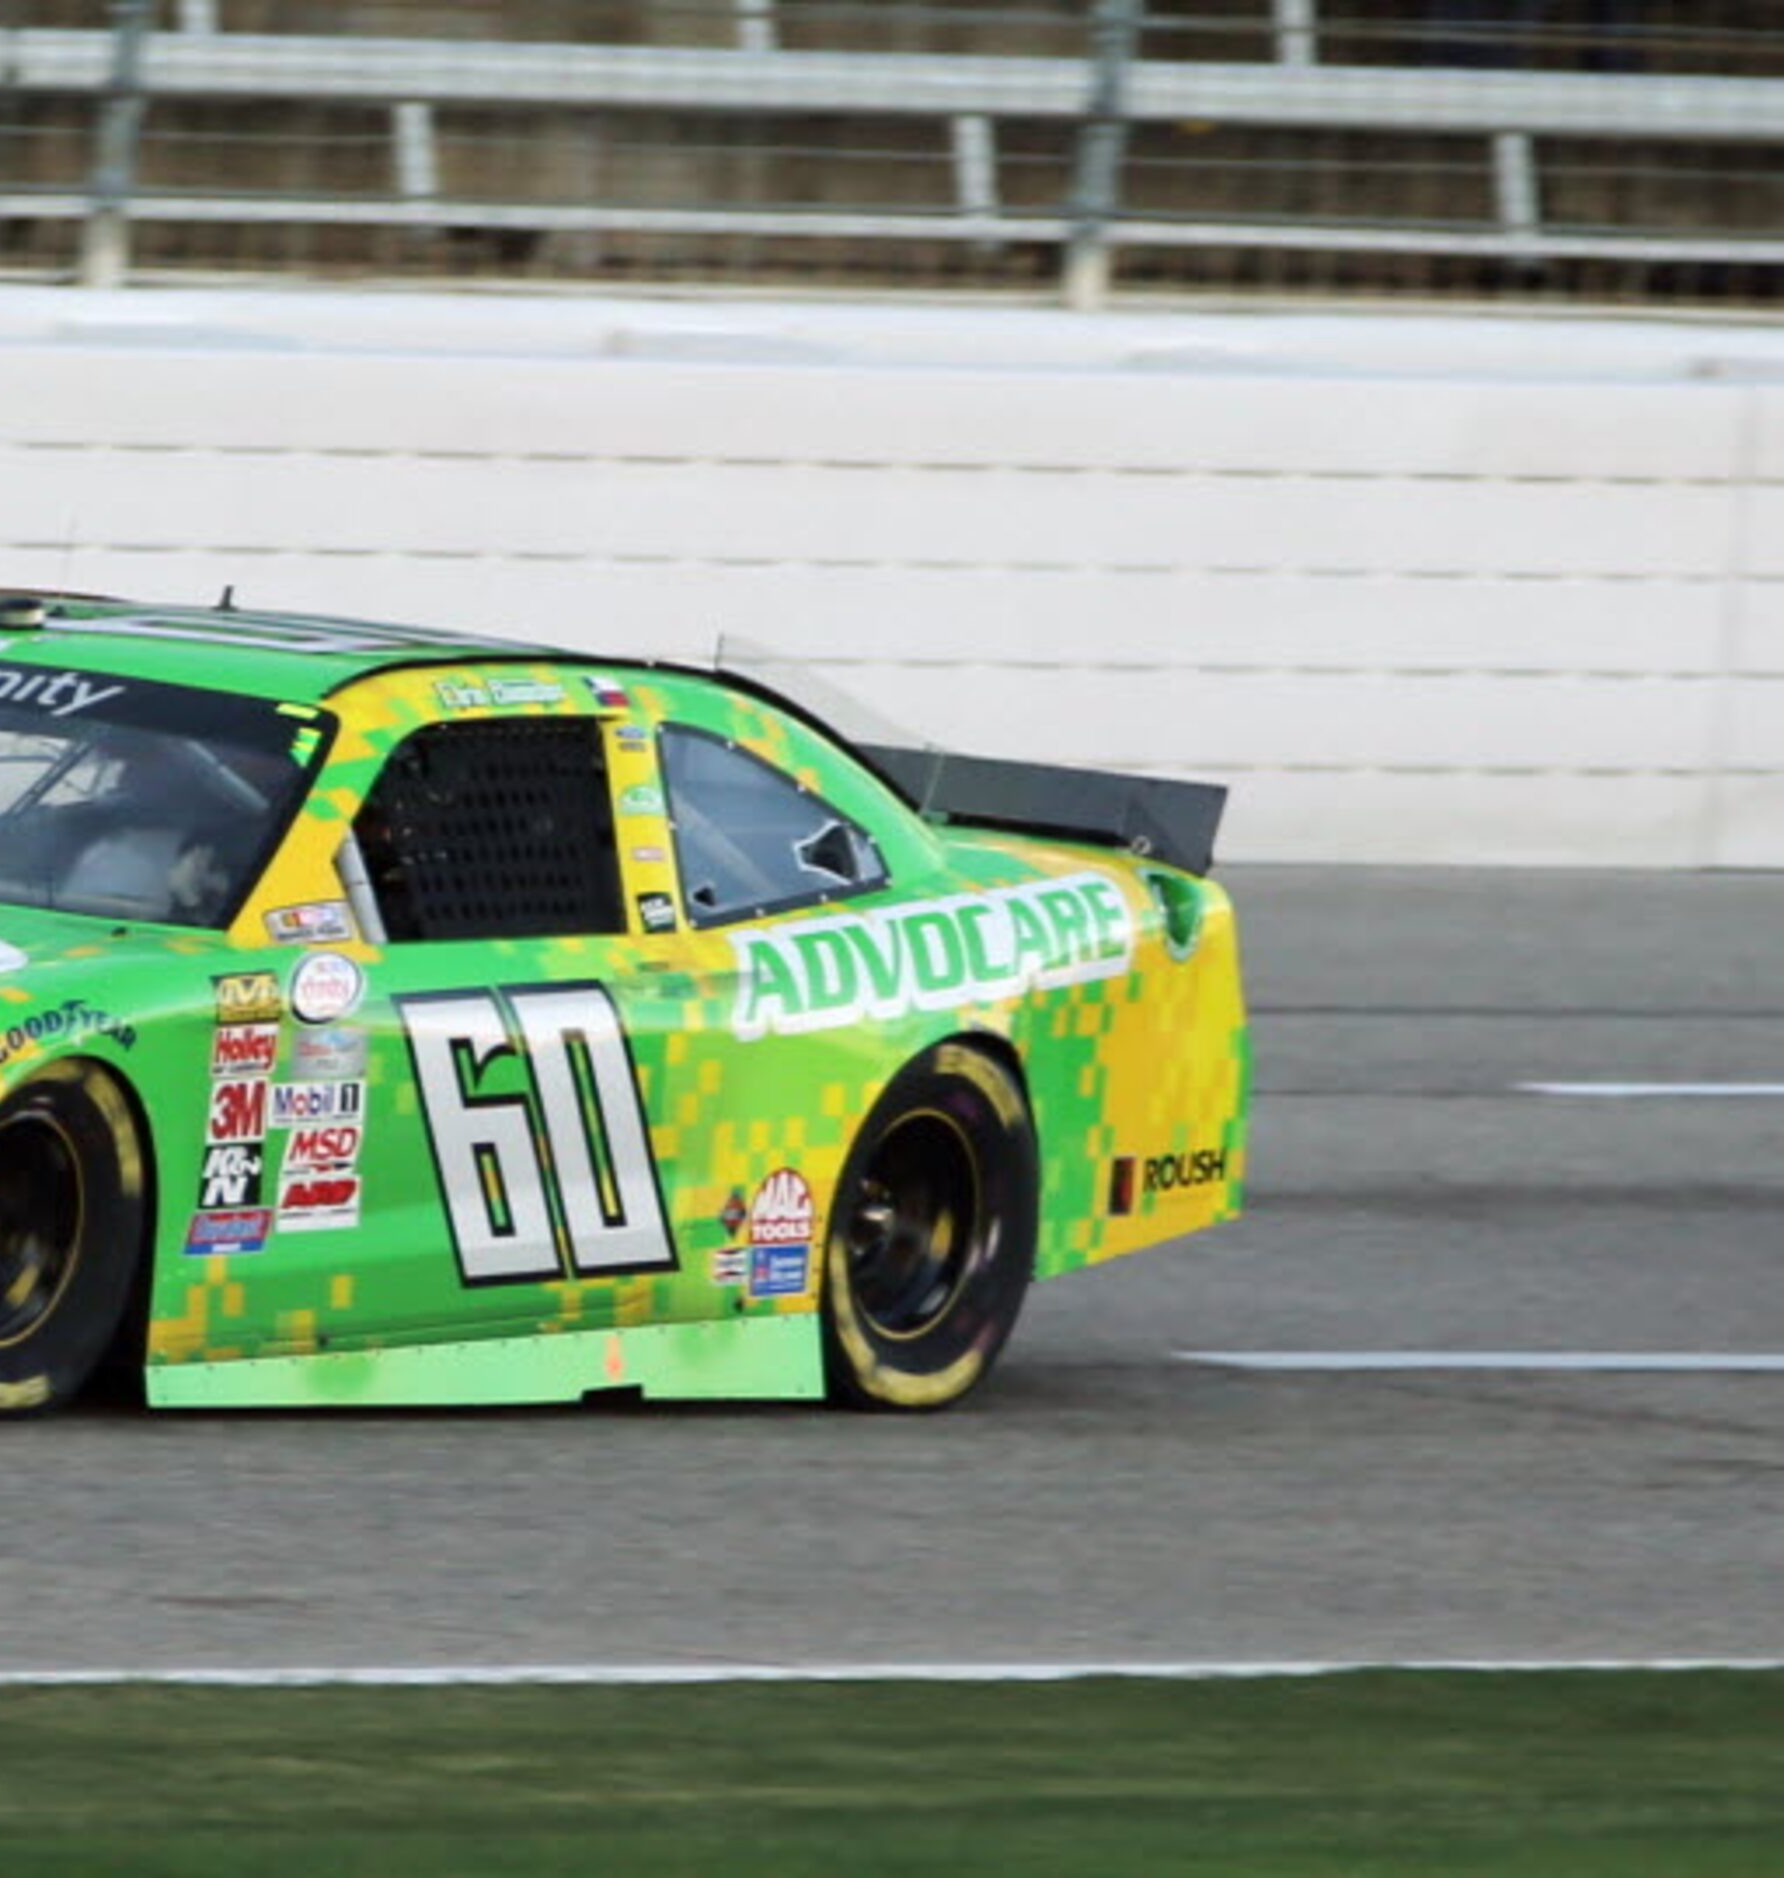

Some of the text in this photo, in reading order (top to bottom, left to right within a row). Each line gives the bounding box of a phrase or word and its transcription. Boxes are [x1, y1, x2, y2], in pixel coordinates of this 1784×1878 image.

[742, 878, 1128, 1030] ADVOCARE
[211, 1080, 266, 1140] 3M
[274, 1083, 360, 1115] Mobil 1
[289, 1127, 359, 1162] MSD
[391, 980, 680, 1288] 60
[1142, 1148, 1227, 1193] ROUSH
[754, 1221, 809, 1241] TOOLS
